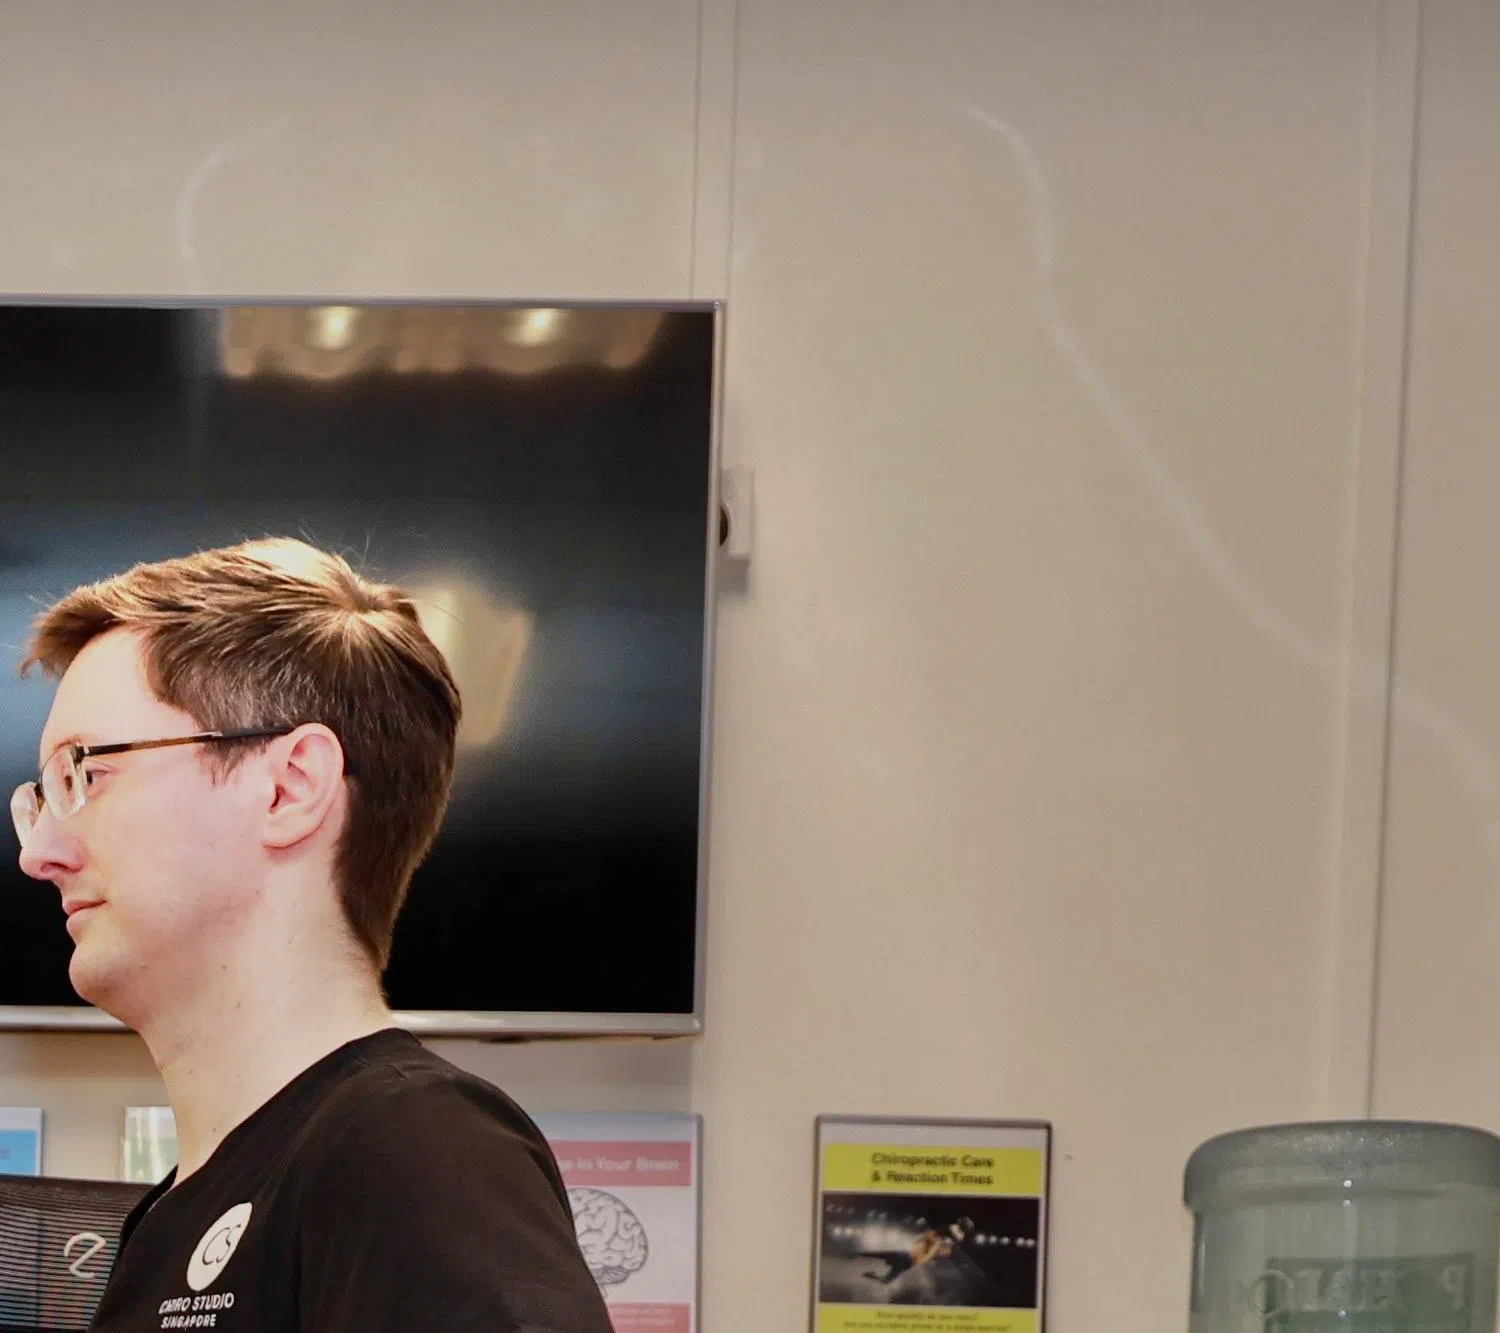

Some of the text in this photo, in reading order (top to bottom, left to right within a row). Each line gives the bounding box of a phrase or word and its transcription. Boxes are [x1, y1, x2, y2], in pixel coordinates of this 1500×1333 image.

[871, 1152, 995, 1168] Chiropractic Care
[886, 1170, 949, 1184] Reaction
[951, 1171, 995, 1185] Times
[158, 1292, 235, 1314] CHIRO STUDIO
[160, 1313, 217, 1329] SINGAPORE
